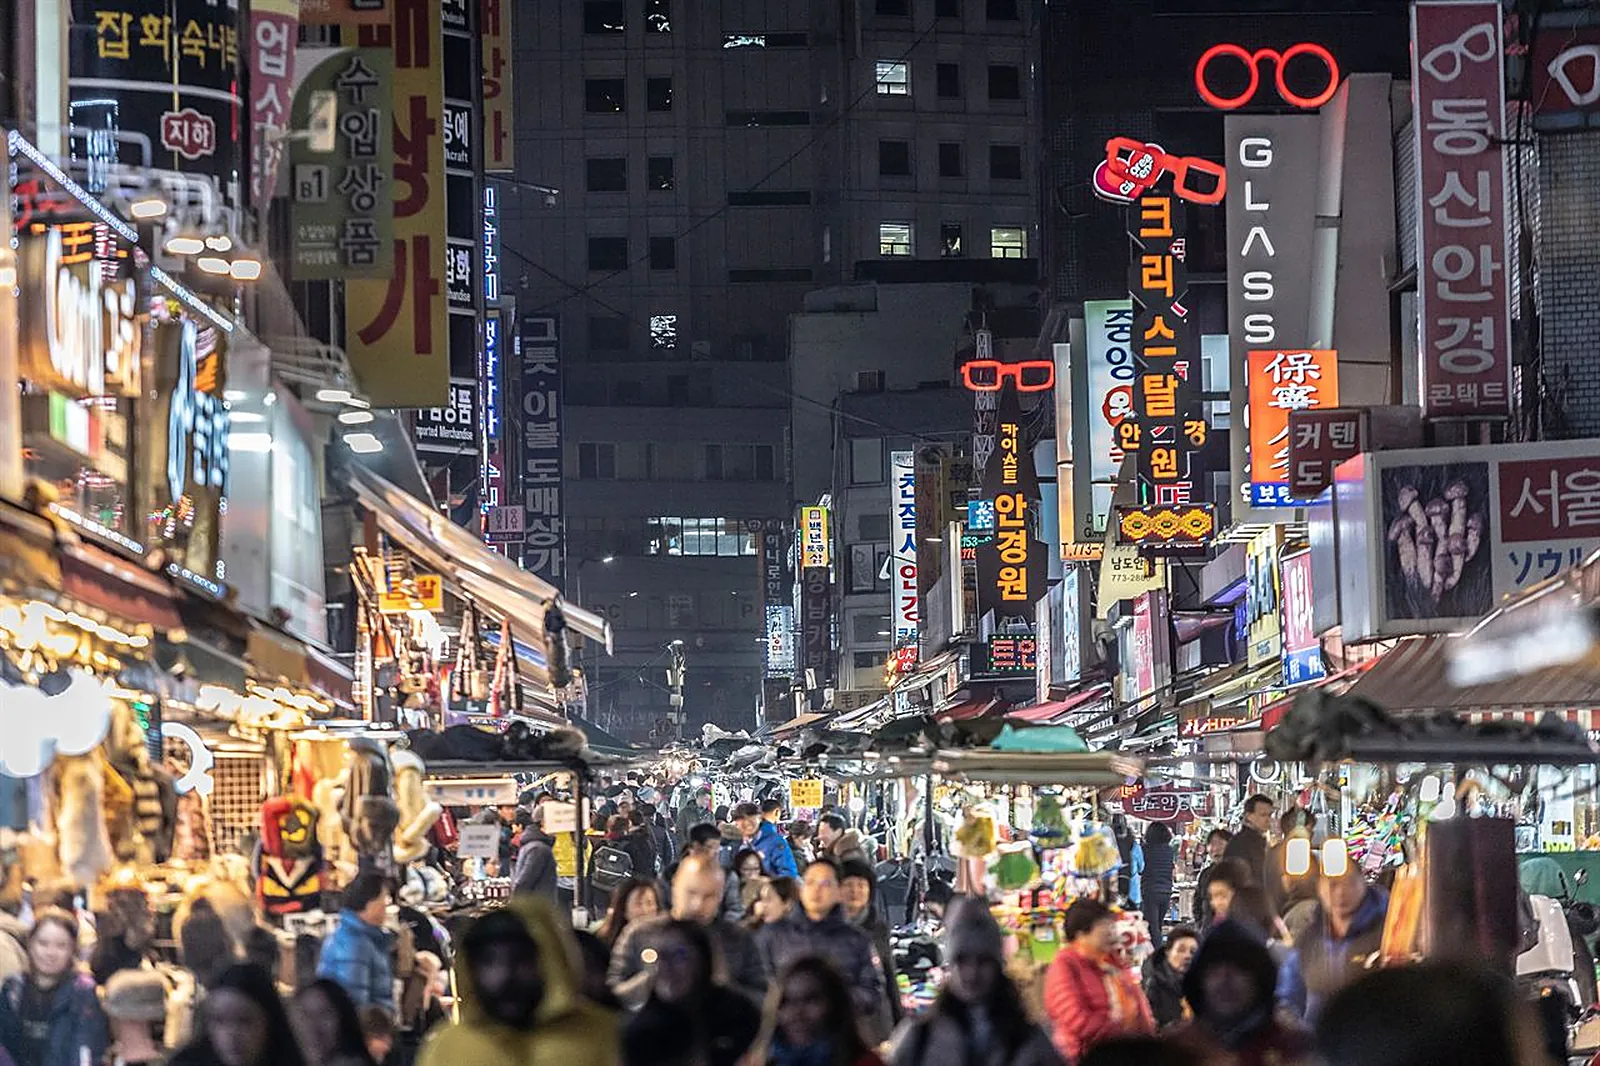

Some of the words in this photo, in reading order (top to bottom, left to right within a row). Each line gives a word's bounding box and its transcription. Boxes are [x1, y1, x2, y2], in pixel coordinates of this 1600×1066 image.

[95, 12, 171, 71] 잡화
[168, 120, 211, 148] 지하
[338, 57, 383, 265] 수입상품
[300, 168, 324, 199] B1
[1238, 138, 1276, 345] GLASS
[1425, 98, 1501, 374] 동신안경
[1139, 196, 1179, 417] 크리스탈
[1430, 382, 1505, 409] 콘택트
[1295, 421, 1356, 449] 커텐
[1509, 469, 1600, 528] 서울
[995, 492, 1028, 601] 안경원
